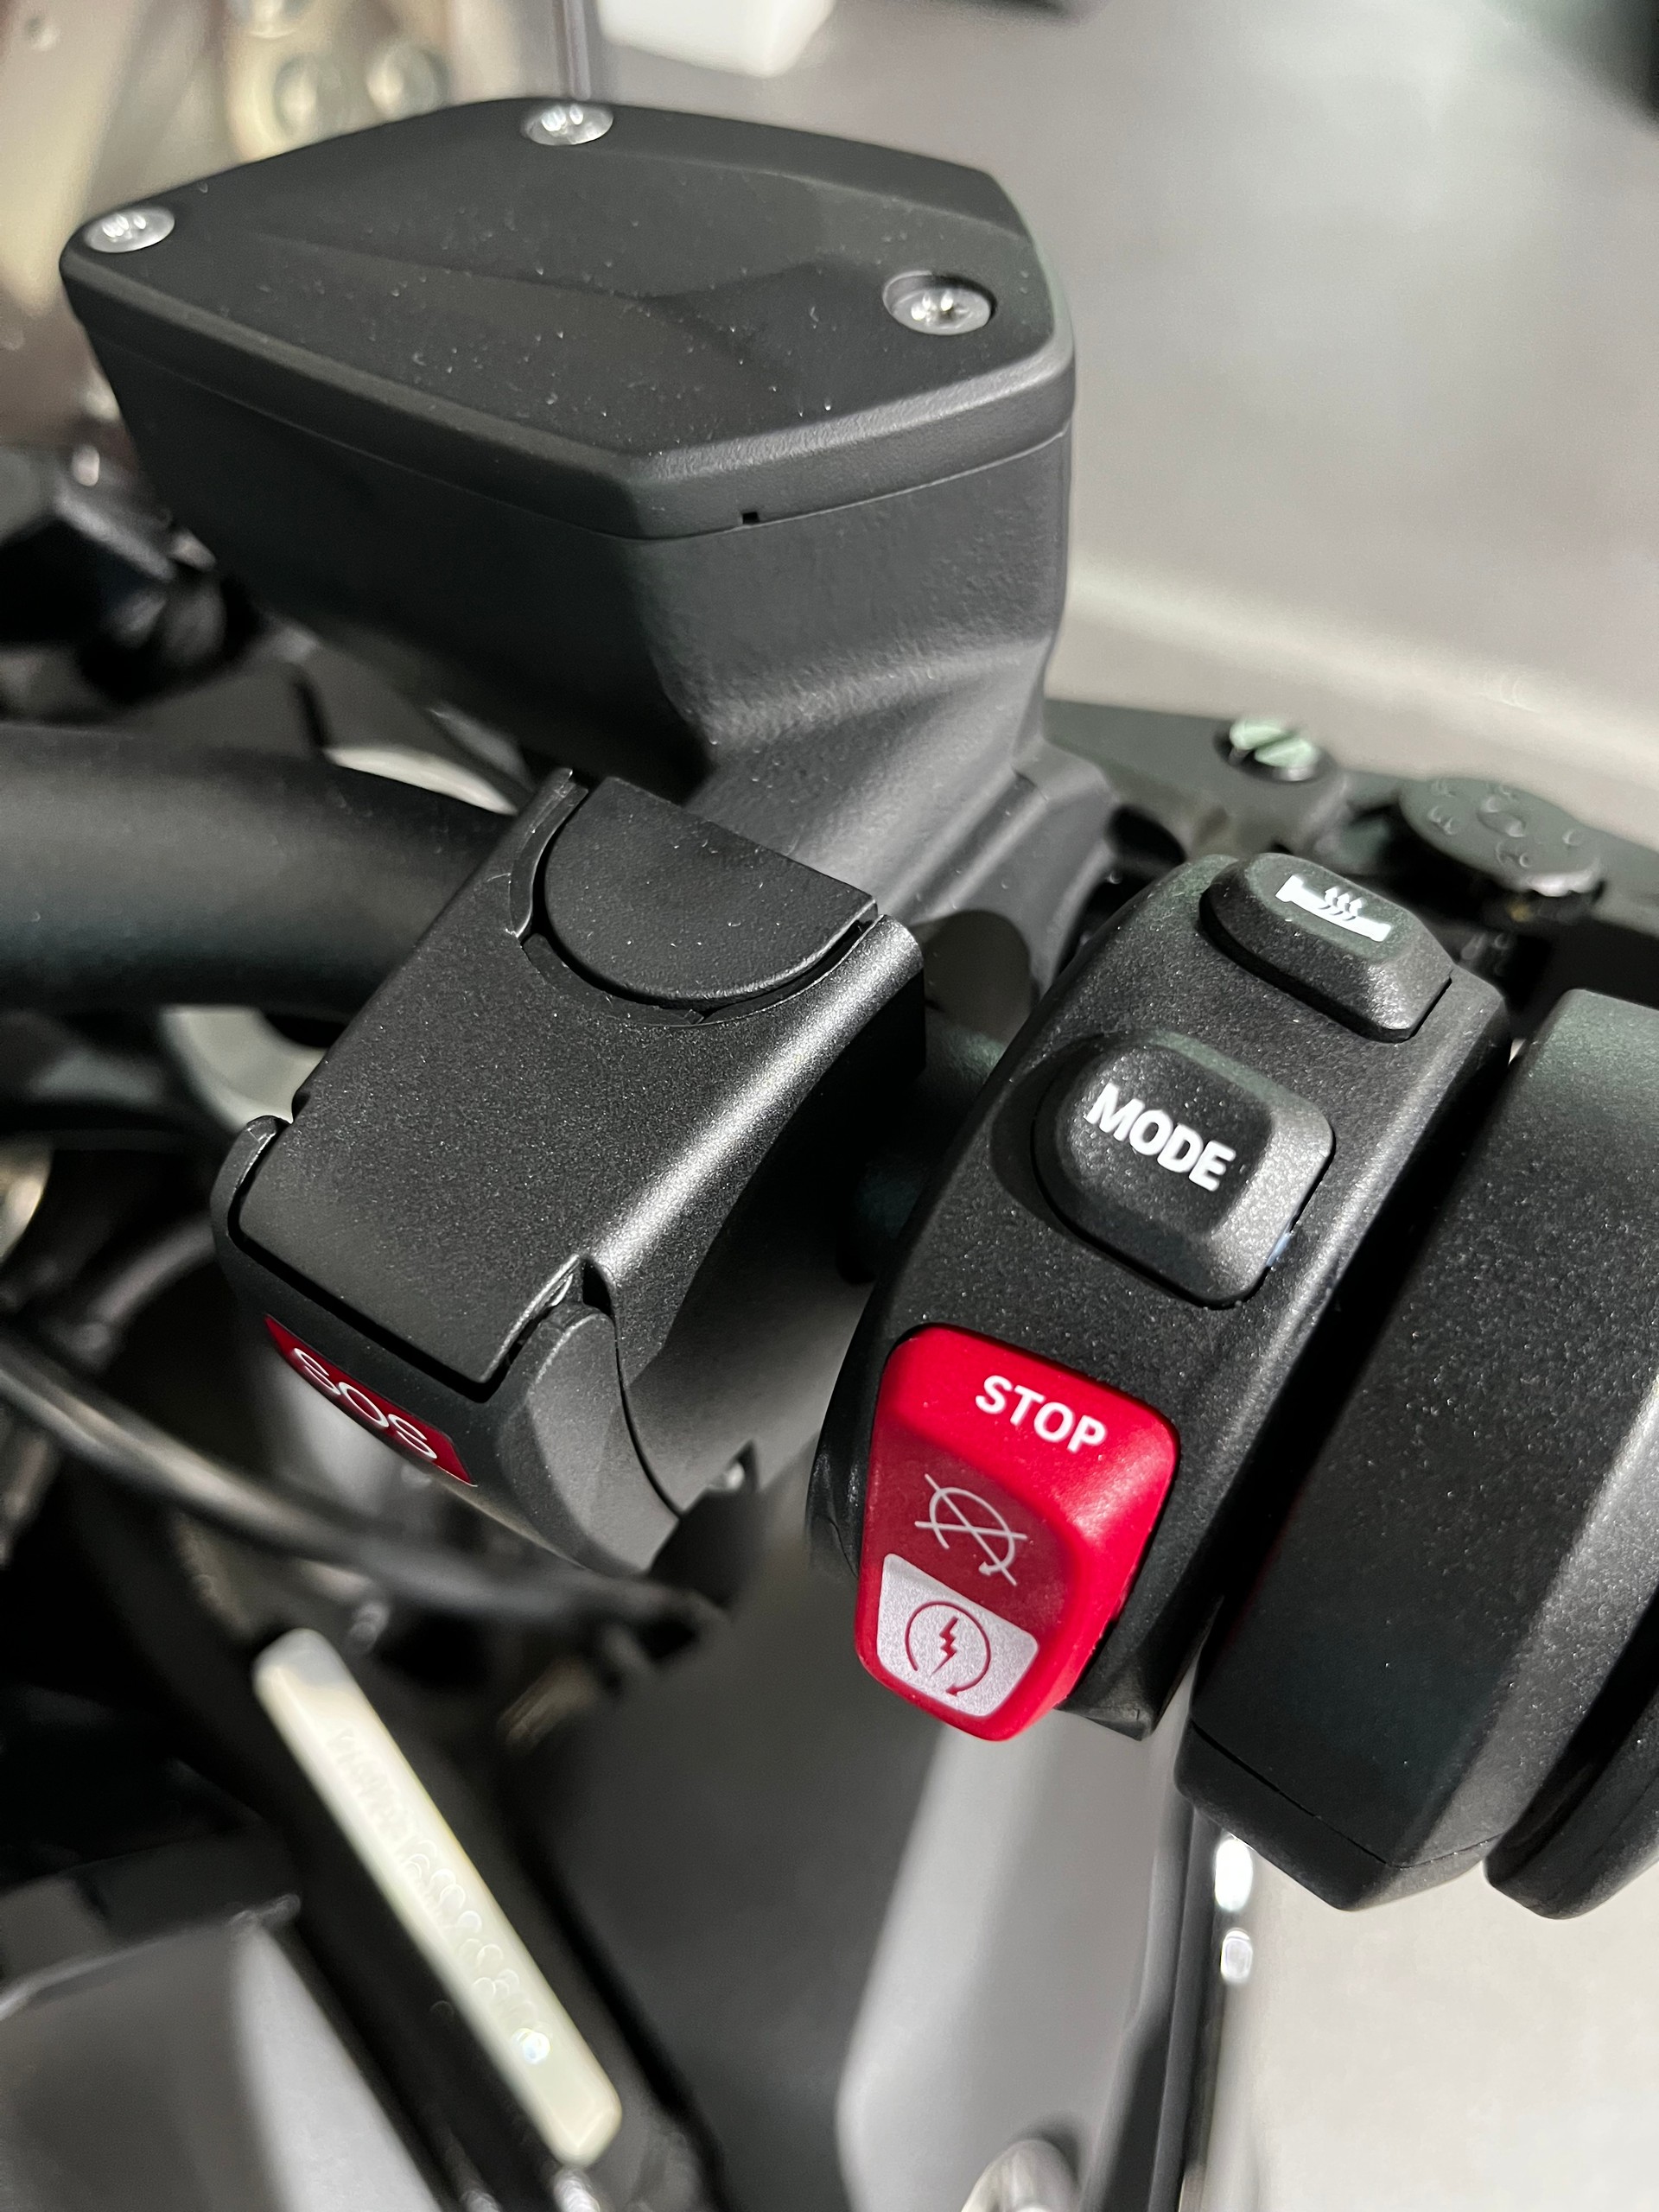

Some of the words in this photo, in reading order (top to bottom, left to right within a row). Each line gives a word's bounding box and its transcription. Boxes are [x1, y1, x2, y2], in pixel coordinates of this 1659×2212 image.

[1083, 1082, 1236, 1192] MODE
[294, 1347, 438, 1459] SOS
[975, 1375, 1108, 1453] STOP
